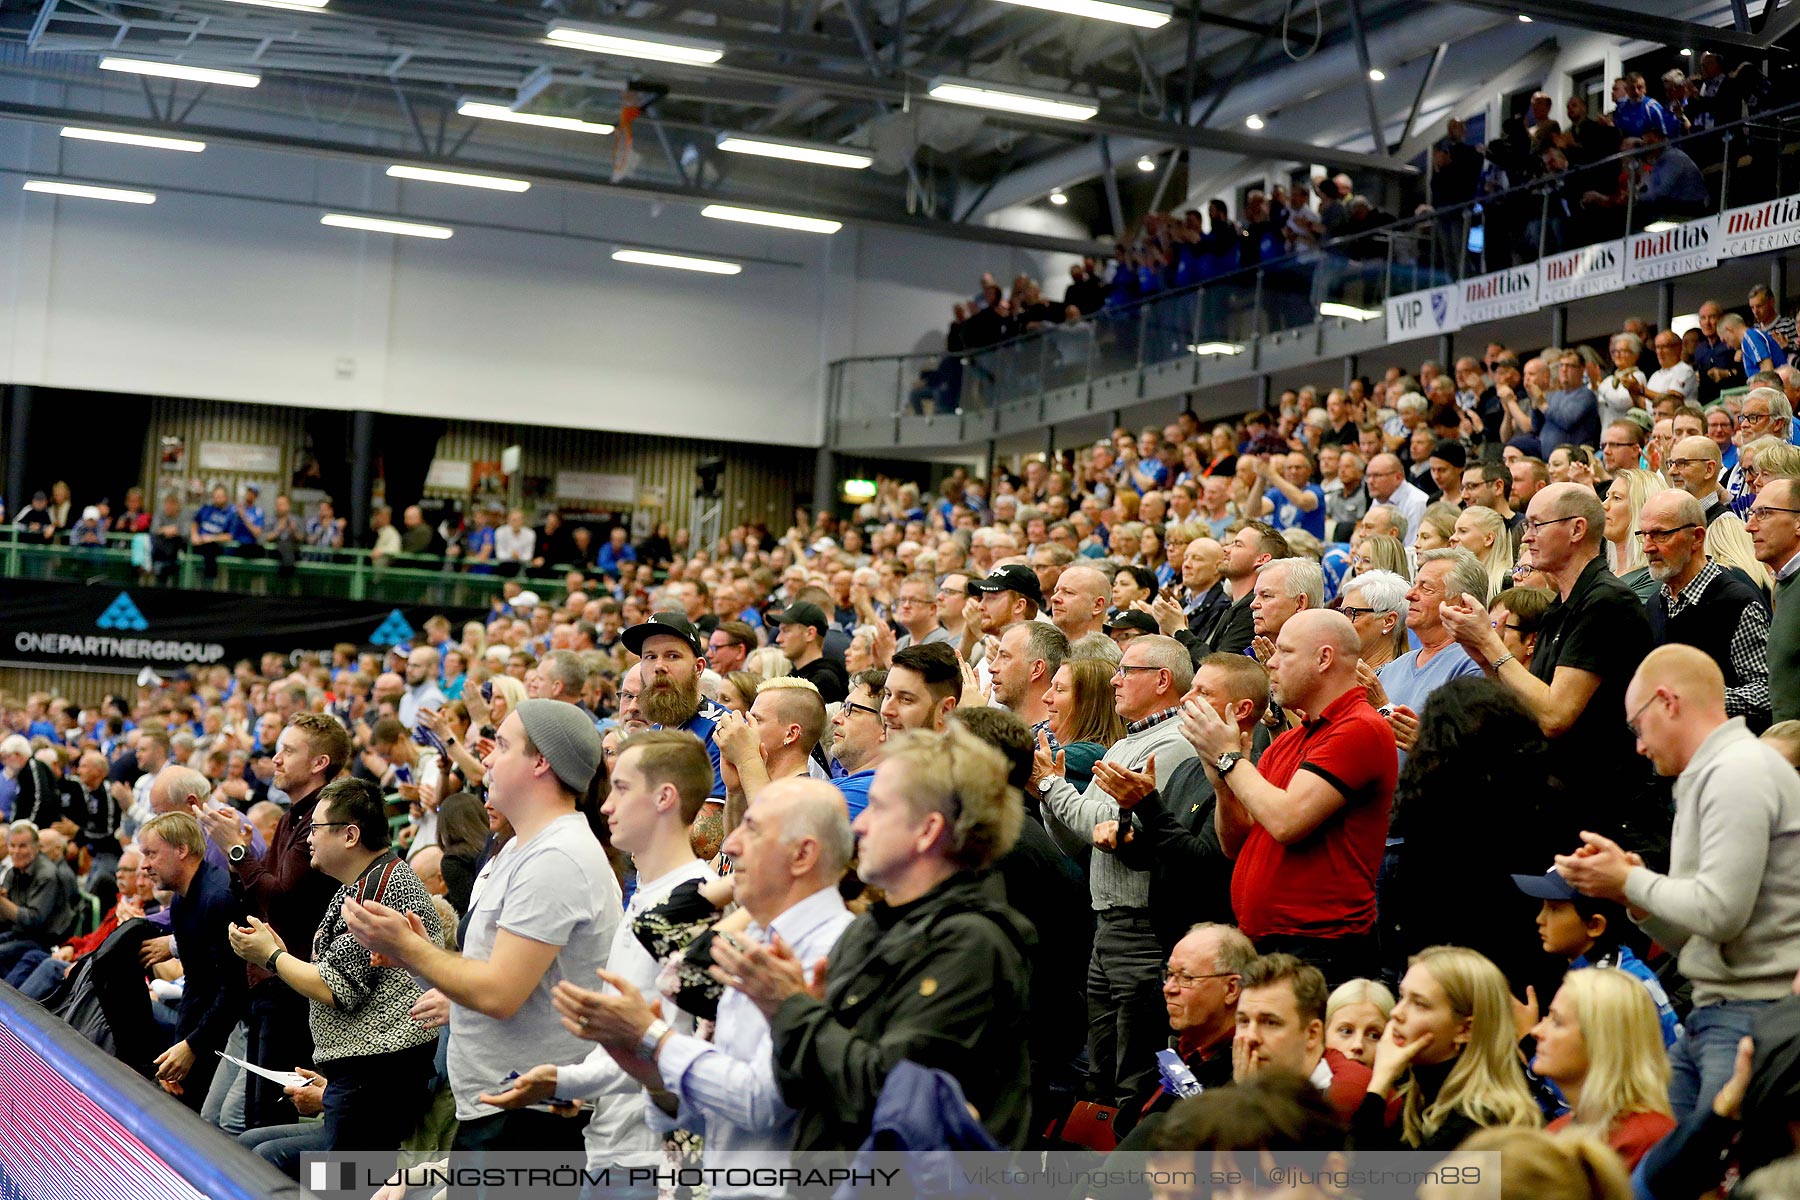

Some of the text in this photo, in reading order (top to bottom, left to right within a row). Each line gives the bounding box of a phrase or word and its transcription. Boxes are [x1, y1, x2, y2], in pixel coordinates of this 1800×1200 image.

[1728, 198, 1800, 235] mattia
[1635, 224, 1709, 260] mattias
[1638, 255, 1703, 283] CATERING
[1466, 270, 1530, 303] mattias
[1396, 300, 1422, 330] VIP
[15, 632, 225, 663] ONEPARTNERGROUP
